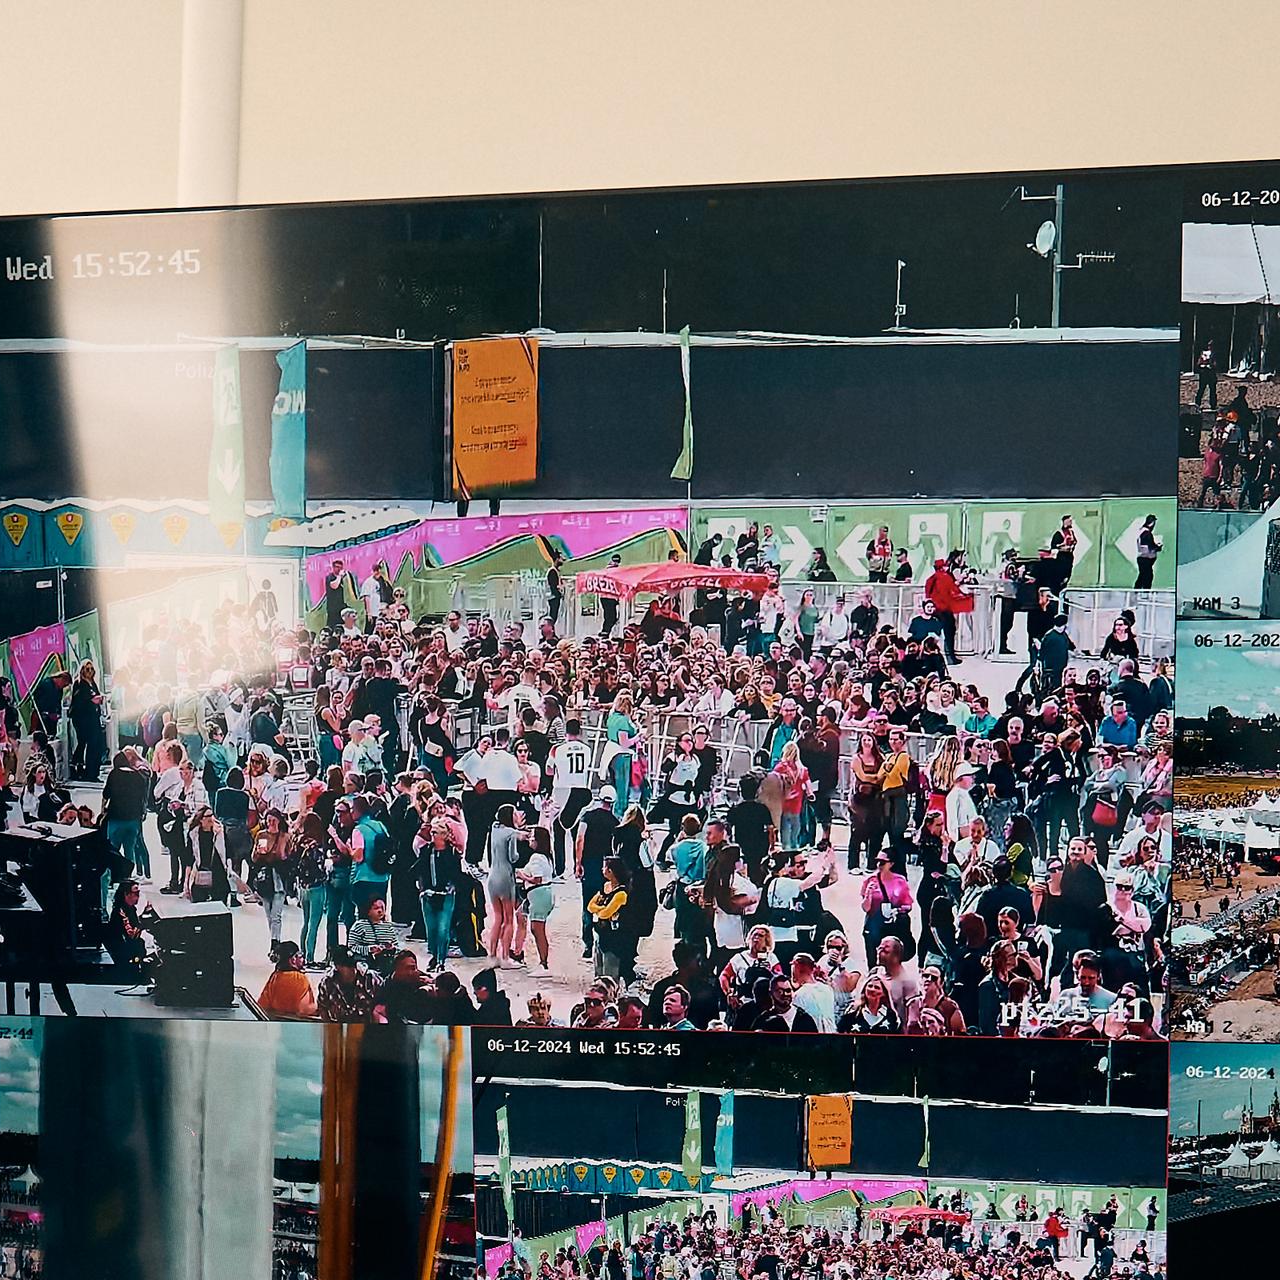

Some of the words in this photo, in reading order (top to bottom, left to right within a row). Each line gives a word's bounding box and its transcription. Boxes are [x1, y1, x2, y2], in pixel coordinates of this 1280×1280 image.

[6, 256, 54, 281] Wed
[73, 249, 201, 279] 15:52:45
[1193, 597, 1222, 610] KAM
[1231, 597, 1241, 610] 3
[567, 753, 585, 774] 10
[1000, 997, 1145, 1027] ptz25-41
[1223, 1020, 1233, 1033] 2
[487, 1039, 572, 1053] 06-12-2024
[579, 1041, 604, 1054] Wed
[614, 1041, 681, 1056] 15:52:45
[1185, 1066, 1275, 1080] 06-12-2024
